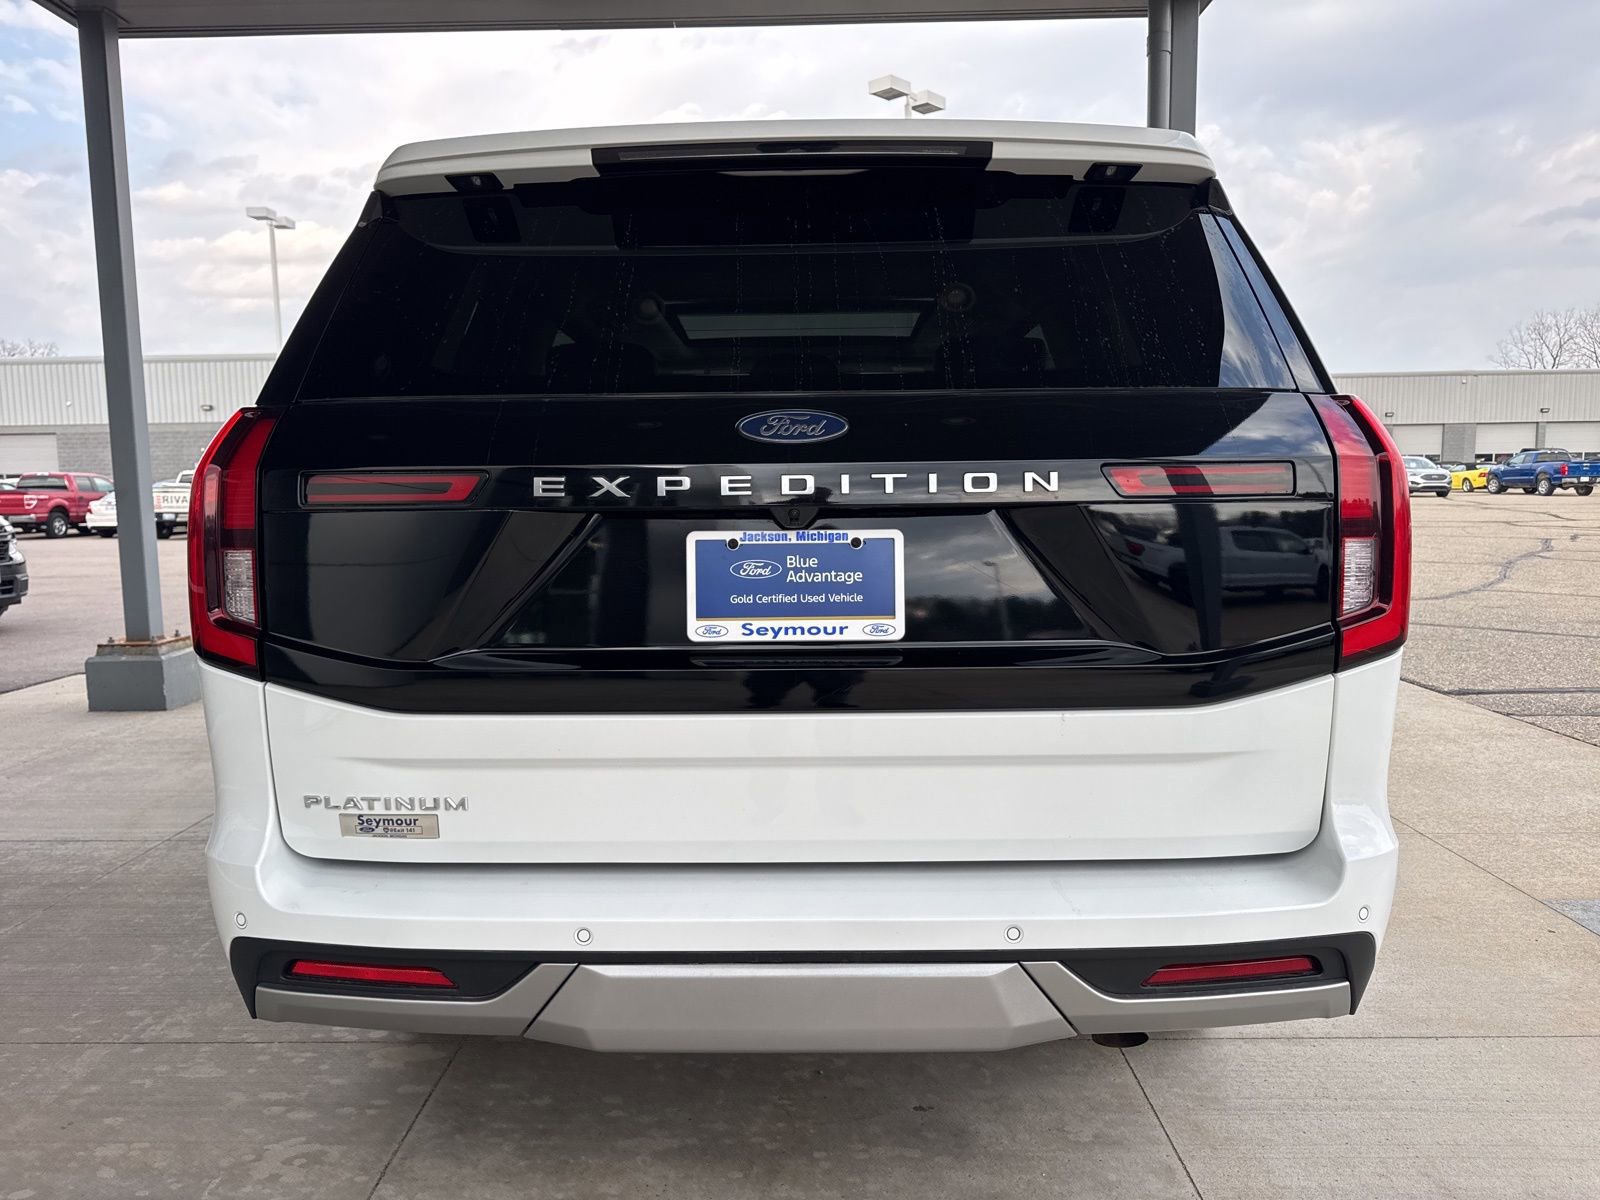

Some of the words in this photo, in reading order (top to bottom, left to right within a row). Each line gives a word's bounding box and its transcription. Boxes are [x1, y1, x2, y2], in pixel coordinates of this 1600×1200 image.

[760, 415, 827, 436] Ford
[532, 470, 1061, 499] EXPEDITION
[739, 532, 792, 543] Jackson,
[795, 531, 849, 543] Michigan
[739, 561, 773, 577] Ford
[786, 555, 818, 568] Blue
[786, 570, 863, 585] Advantage
[730, 594, 753, 604] Gold
[756, 593, 798, 604] Certified
[800, 593, 826, 603] Used
[828, 592, 864, 603] Vehicle
[702, 626, 722, 637] Ford
[741, 622, 849, 639] Seymour
[869, 624, 890, 635] Ford
[303, 794, 469, 811] PLATINUM
[357, 814, 419, 829] Seymour
